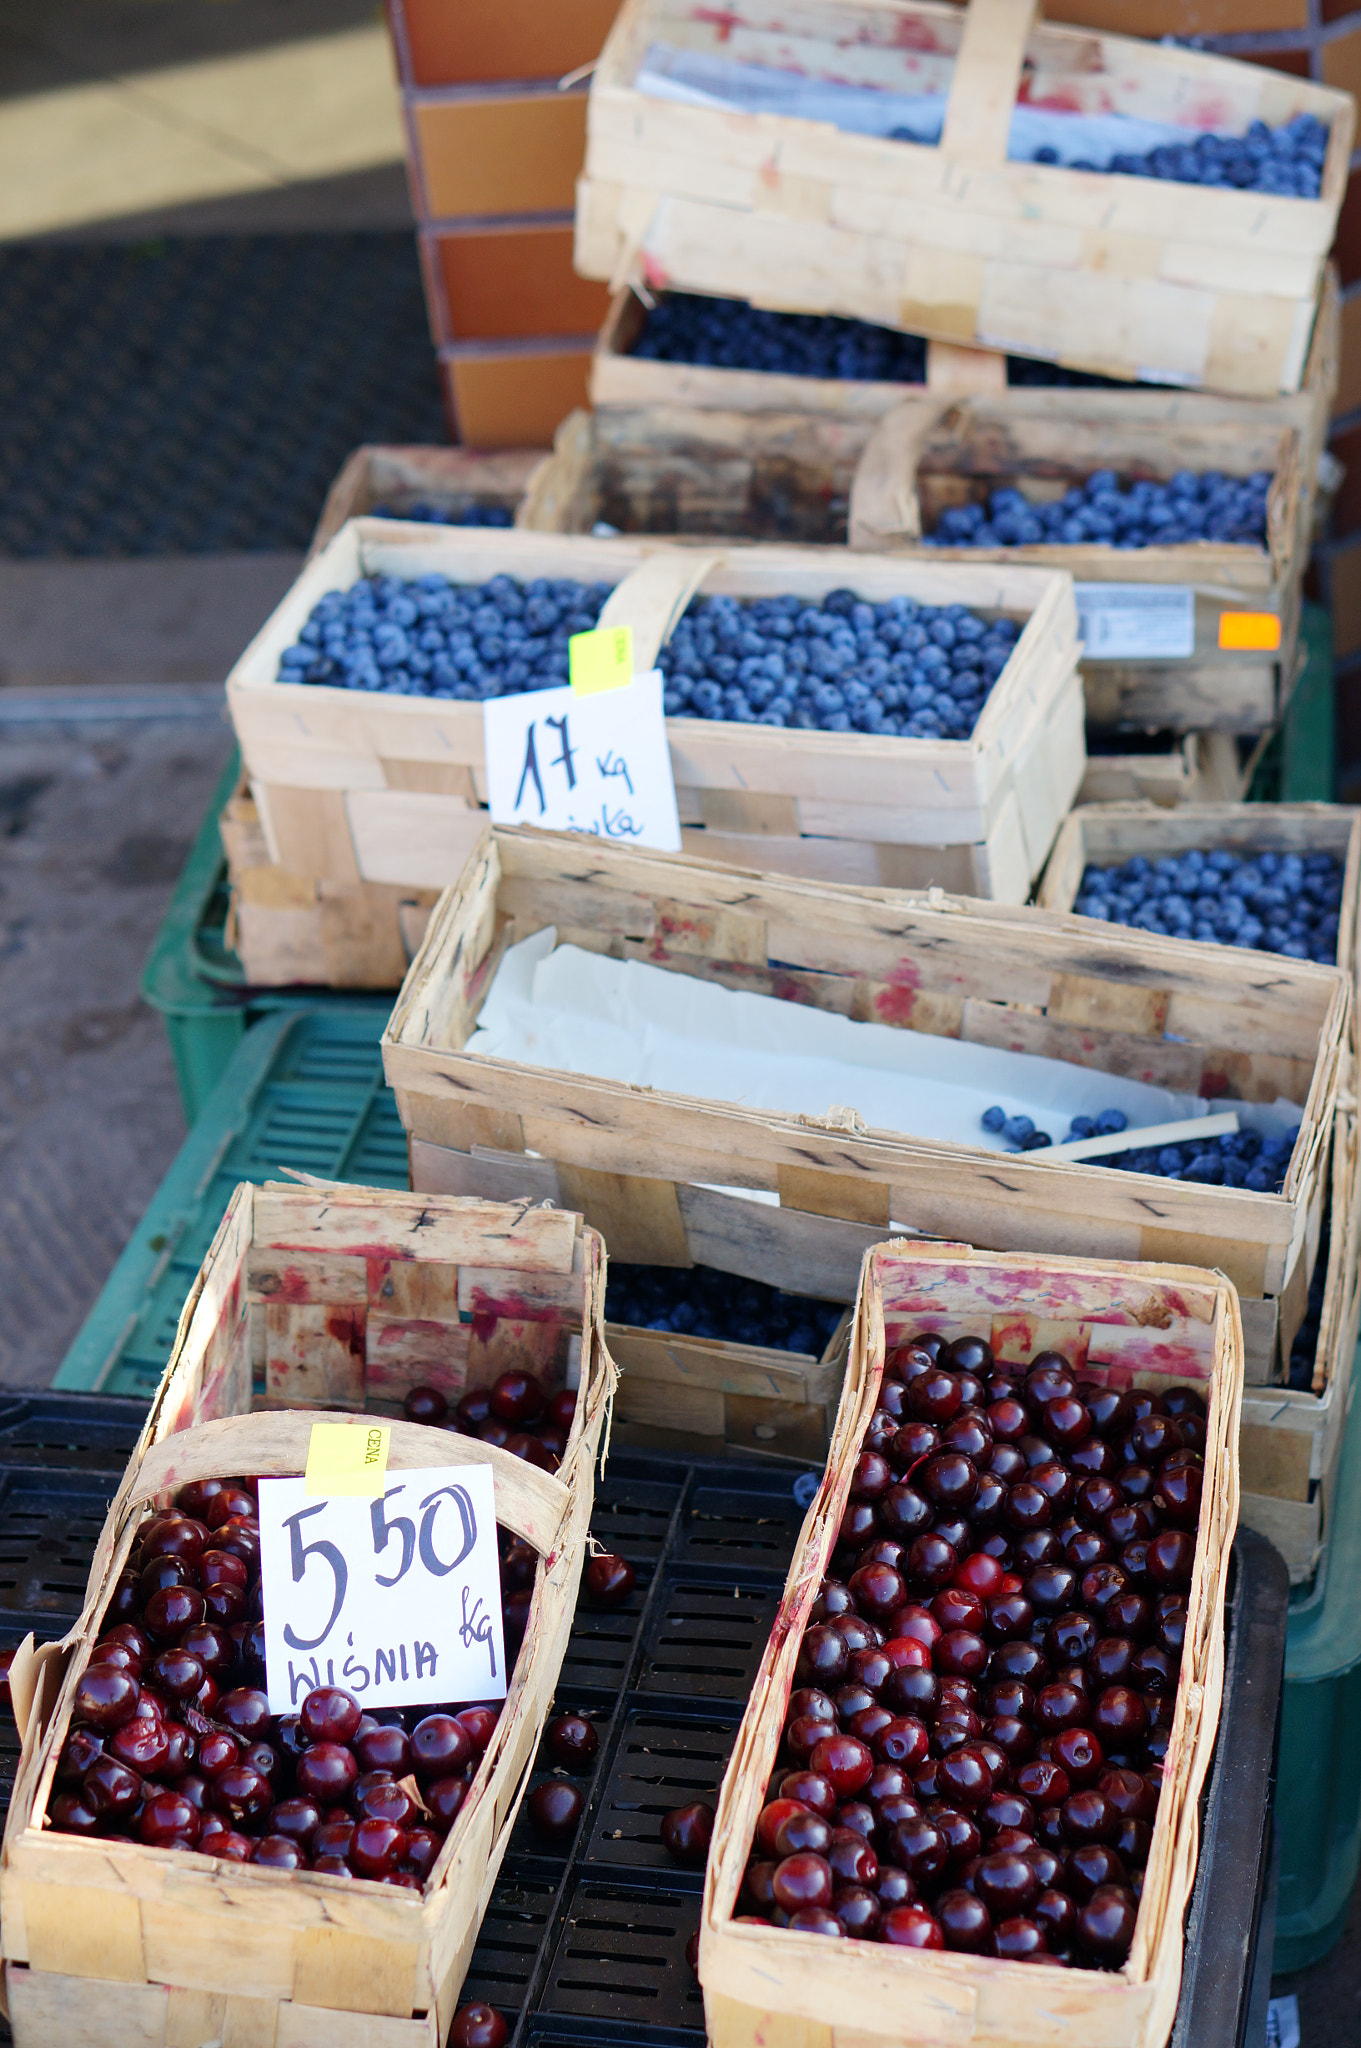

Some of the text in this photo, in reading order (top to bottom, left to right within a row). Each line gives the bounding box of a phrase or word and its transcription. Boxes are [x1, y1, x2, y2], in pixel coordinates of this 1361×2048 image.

[514, 713, 577, 816] 17
[364, 1428, 382, 1465] CENA
[281, 1483, 477, 1651] 5 50
[287, 1631, 439, 1706] WIŚNIA
